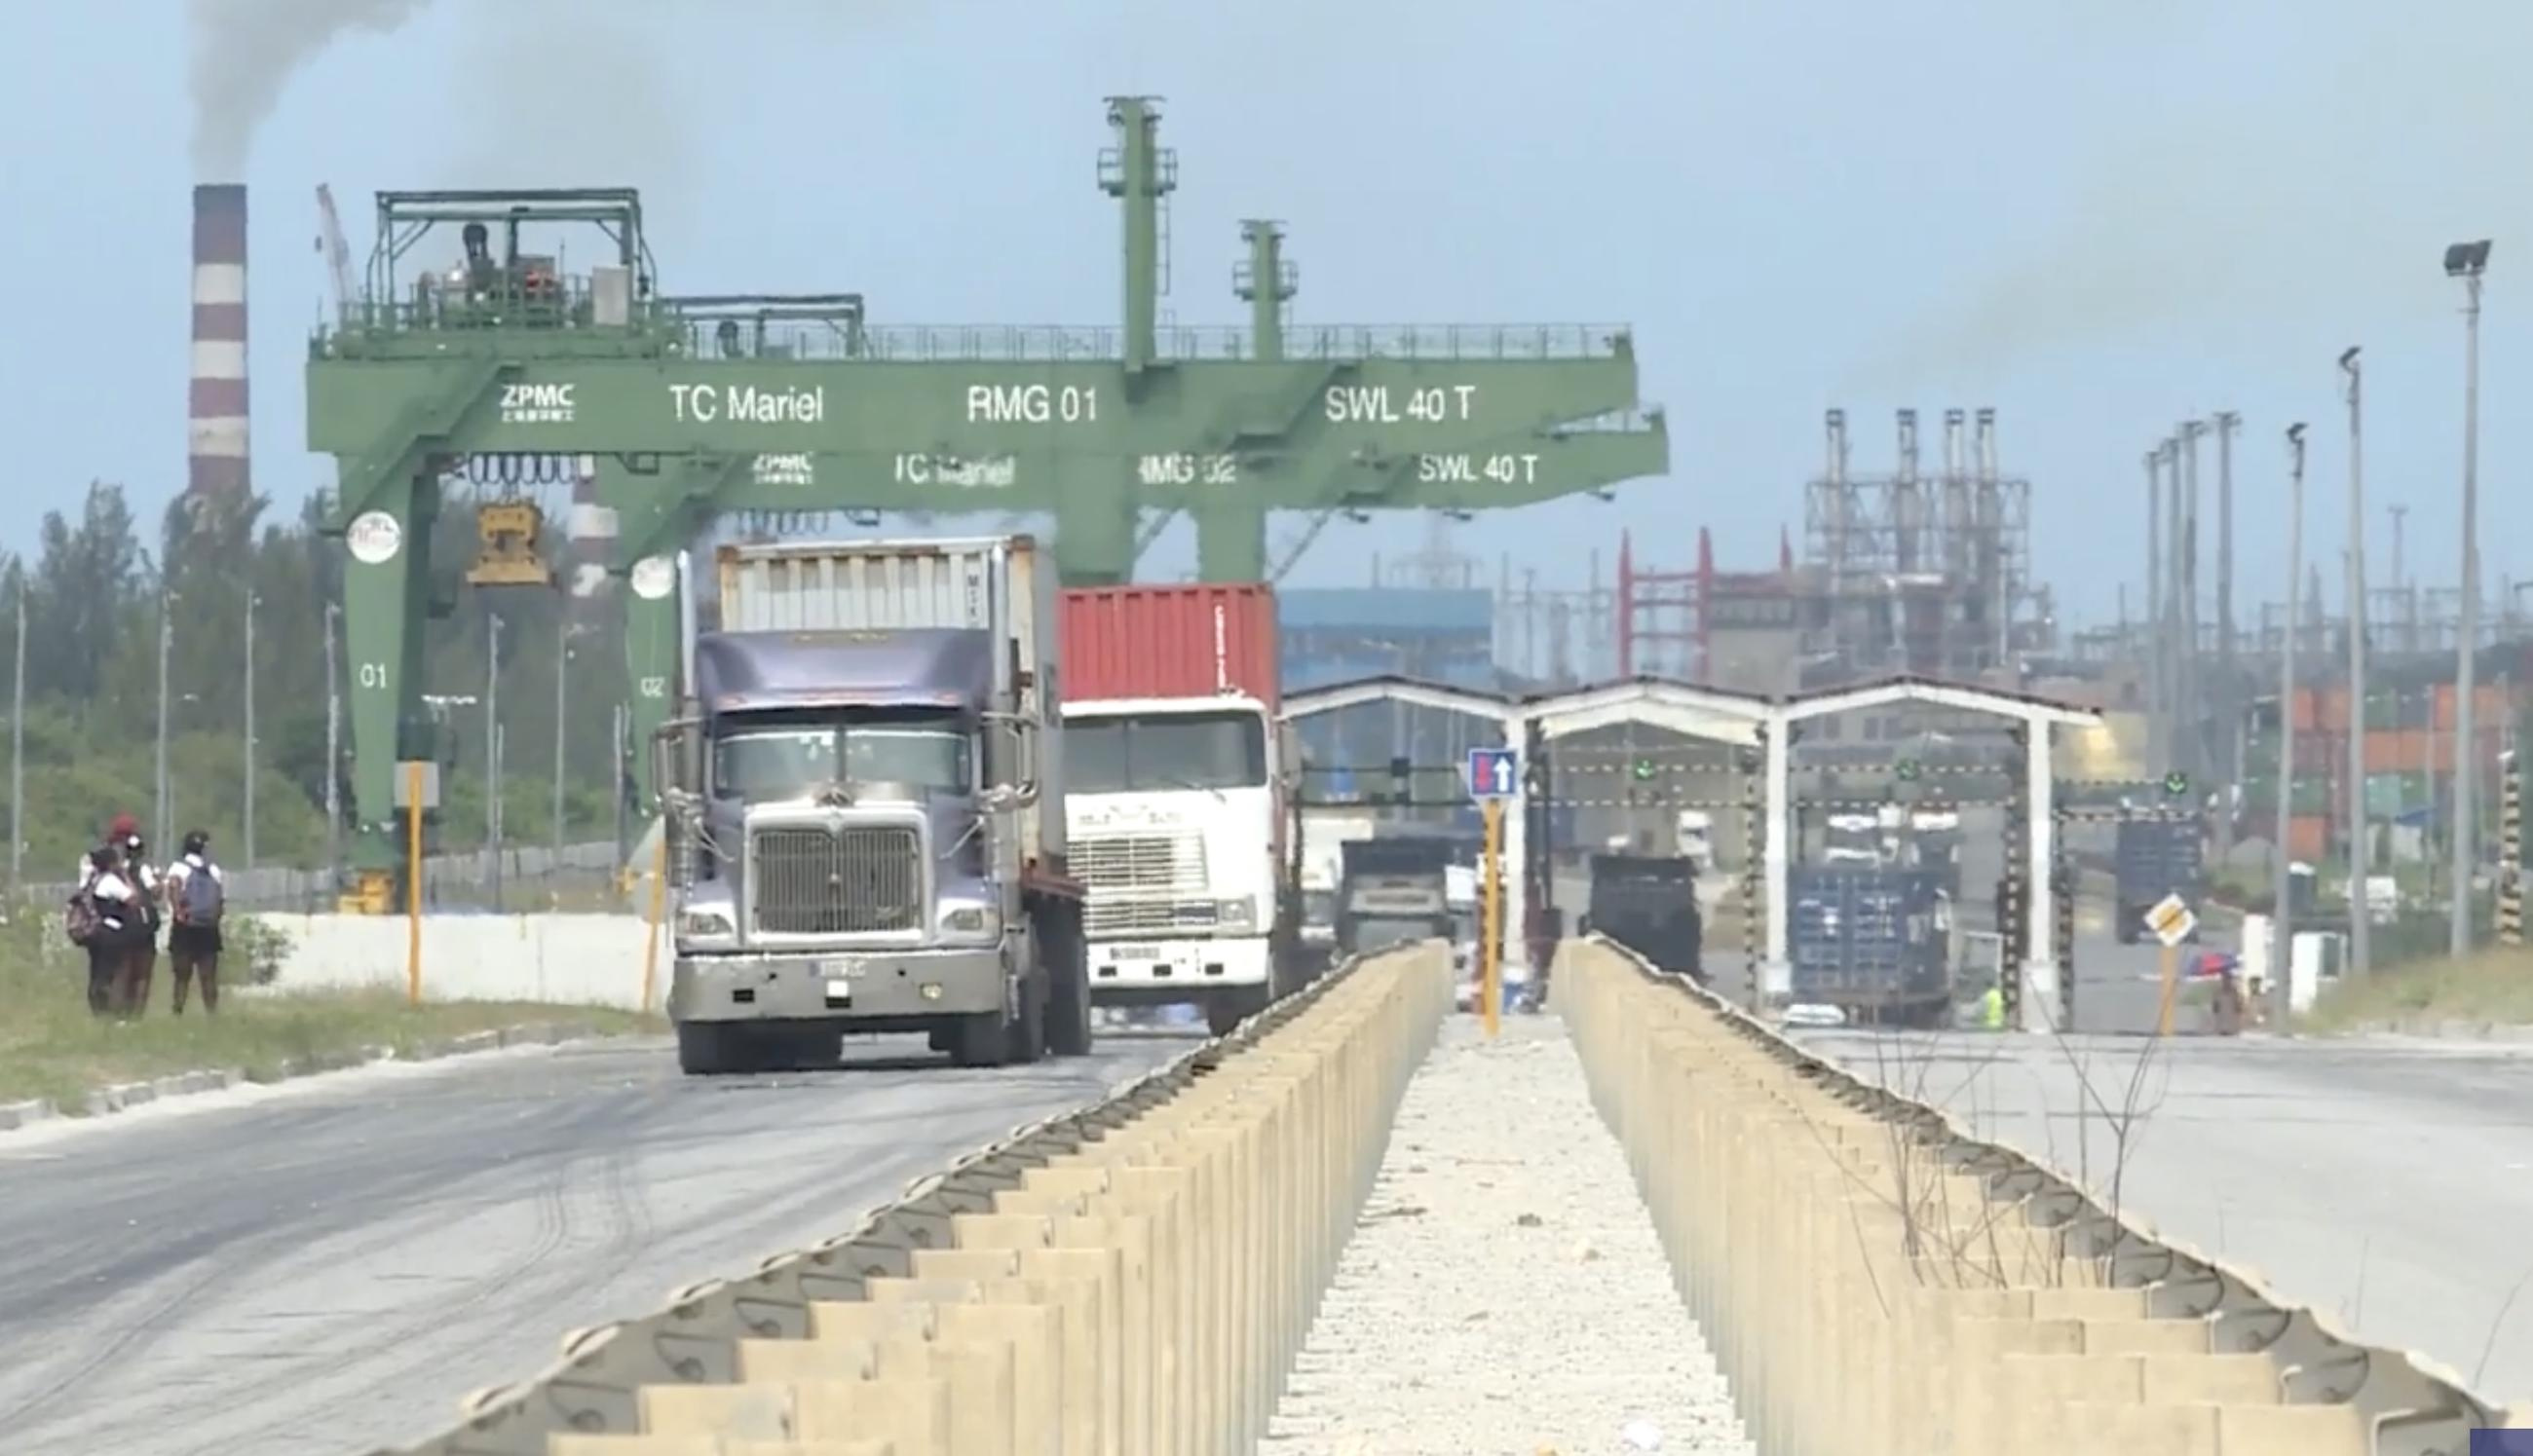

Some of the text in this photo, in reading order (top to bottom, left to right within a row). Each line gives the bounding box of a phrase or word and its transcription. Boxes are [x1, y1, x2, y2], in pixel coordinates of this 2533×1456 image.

[500, 384, 575, 407] ZPMC
[669, 385, 822, 422] TC Mariel
[967, 385, 1096, 422] RMG 01
[1326, 386, 1476, 422] SWL 40 T
[1419, 454, 1538, 483] SWL 40 T
[360, 663, 386, 689] 01
[640, 677, 664, 697] 02
